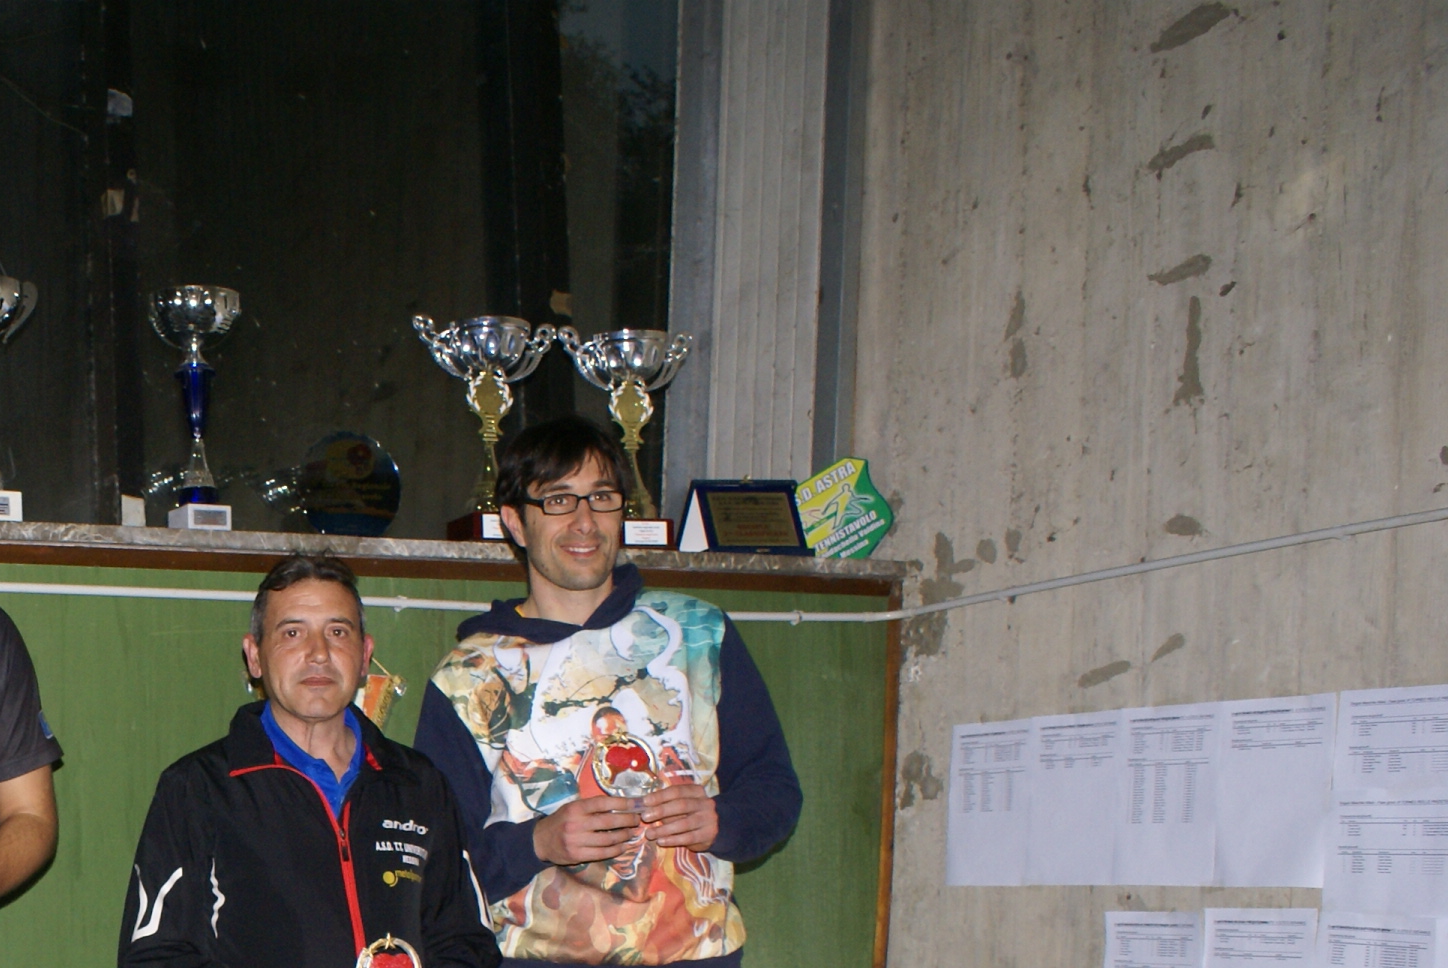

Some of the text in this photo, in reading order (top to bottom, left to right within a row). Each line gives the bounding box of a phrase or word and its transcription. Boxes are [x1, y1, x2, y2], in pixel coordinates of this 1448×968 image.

[815, 462, 856, 493] ASTRA
[814, 510, 877, 553] TENNISTAVOLO
[382, 819, 428, 835] andro
